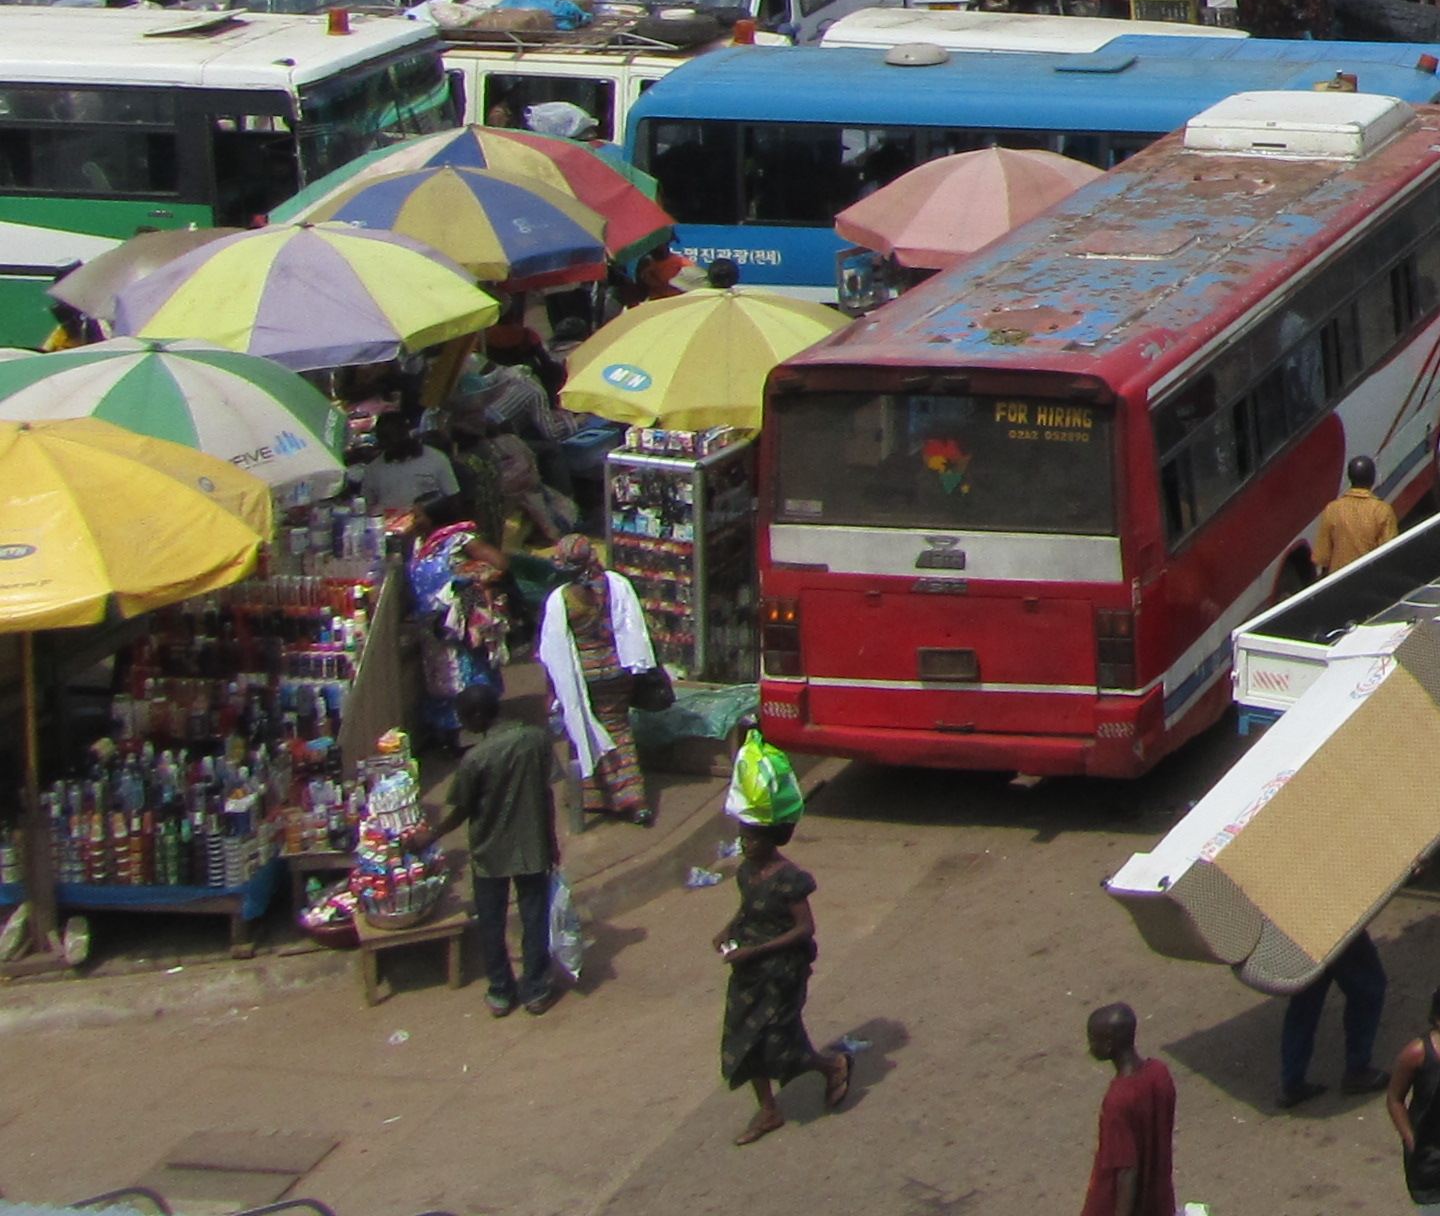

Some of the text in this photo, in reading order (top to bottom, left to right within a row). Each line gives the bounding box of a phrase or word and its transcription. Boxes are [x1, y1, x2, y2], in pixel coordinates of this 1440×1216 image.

[609, 367, 648, 388] MTN
[996, 402, 1093, 429] FOR HIRING
